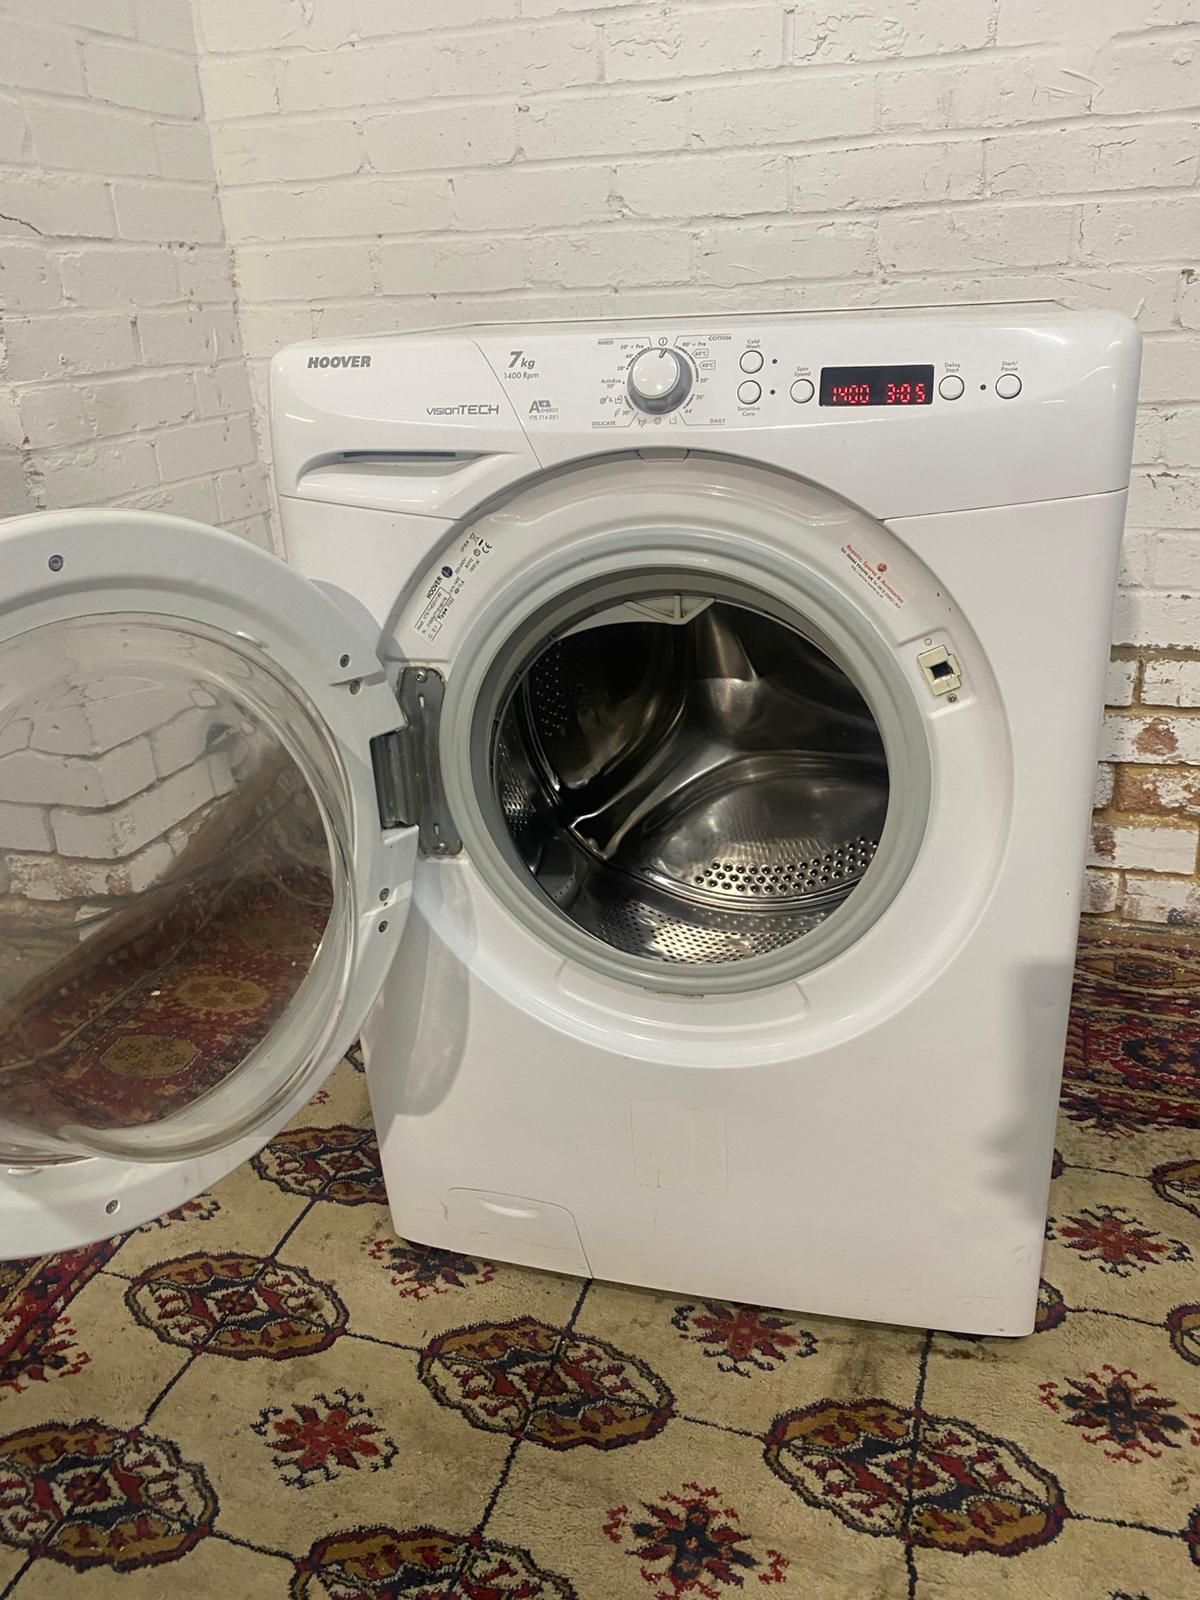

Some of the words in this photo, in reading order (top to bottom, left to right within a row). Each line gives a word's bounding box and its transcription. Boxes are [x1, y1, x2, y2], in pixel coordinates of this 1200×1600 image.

[307, 355, 371, 368] HOOVER
[523, 371, 539, 380] Rpm
[833, 384, 870, 404] 1400
[886, 383, 925, 403] 3:05
[426, 576, 443, 599] HOOVER
[881, 580, 904, 603] Accessories
